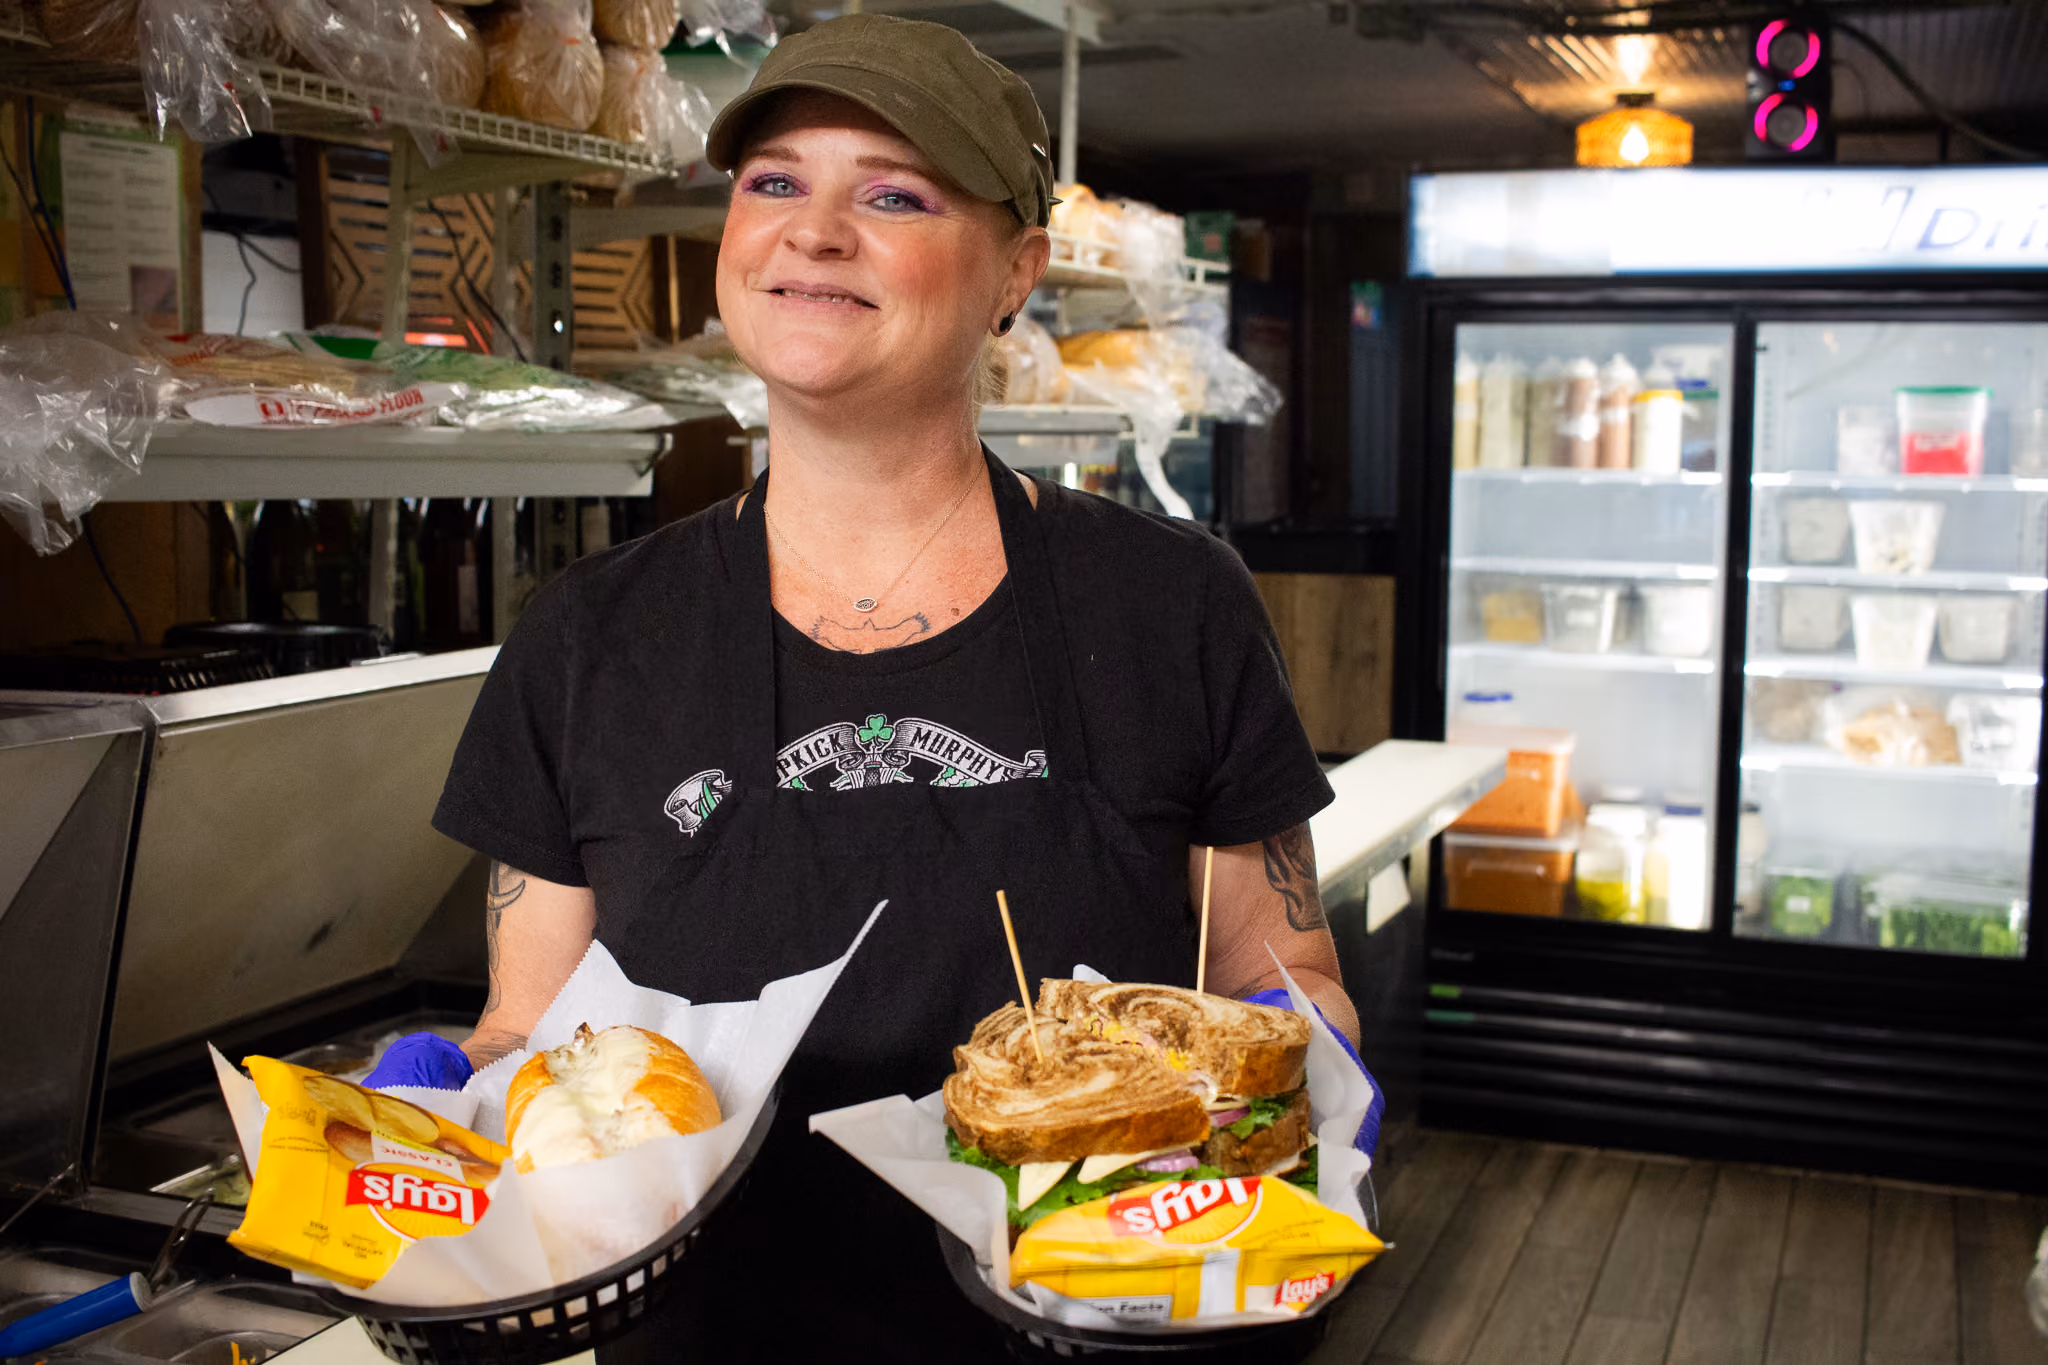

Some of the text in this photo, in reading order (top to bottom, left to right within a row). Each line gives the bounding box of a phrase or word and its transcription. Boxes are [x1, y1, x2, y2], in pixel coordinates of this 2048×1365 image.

[777, 730, 846, 779] PKICK
[363, 1173, 475, 1226] Lay's
[1122, 1177, 1249, 1237] Lay's
[1281, 1273, 1329, 1303] Lay's
